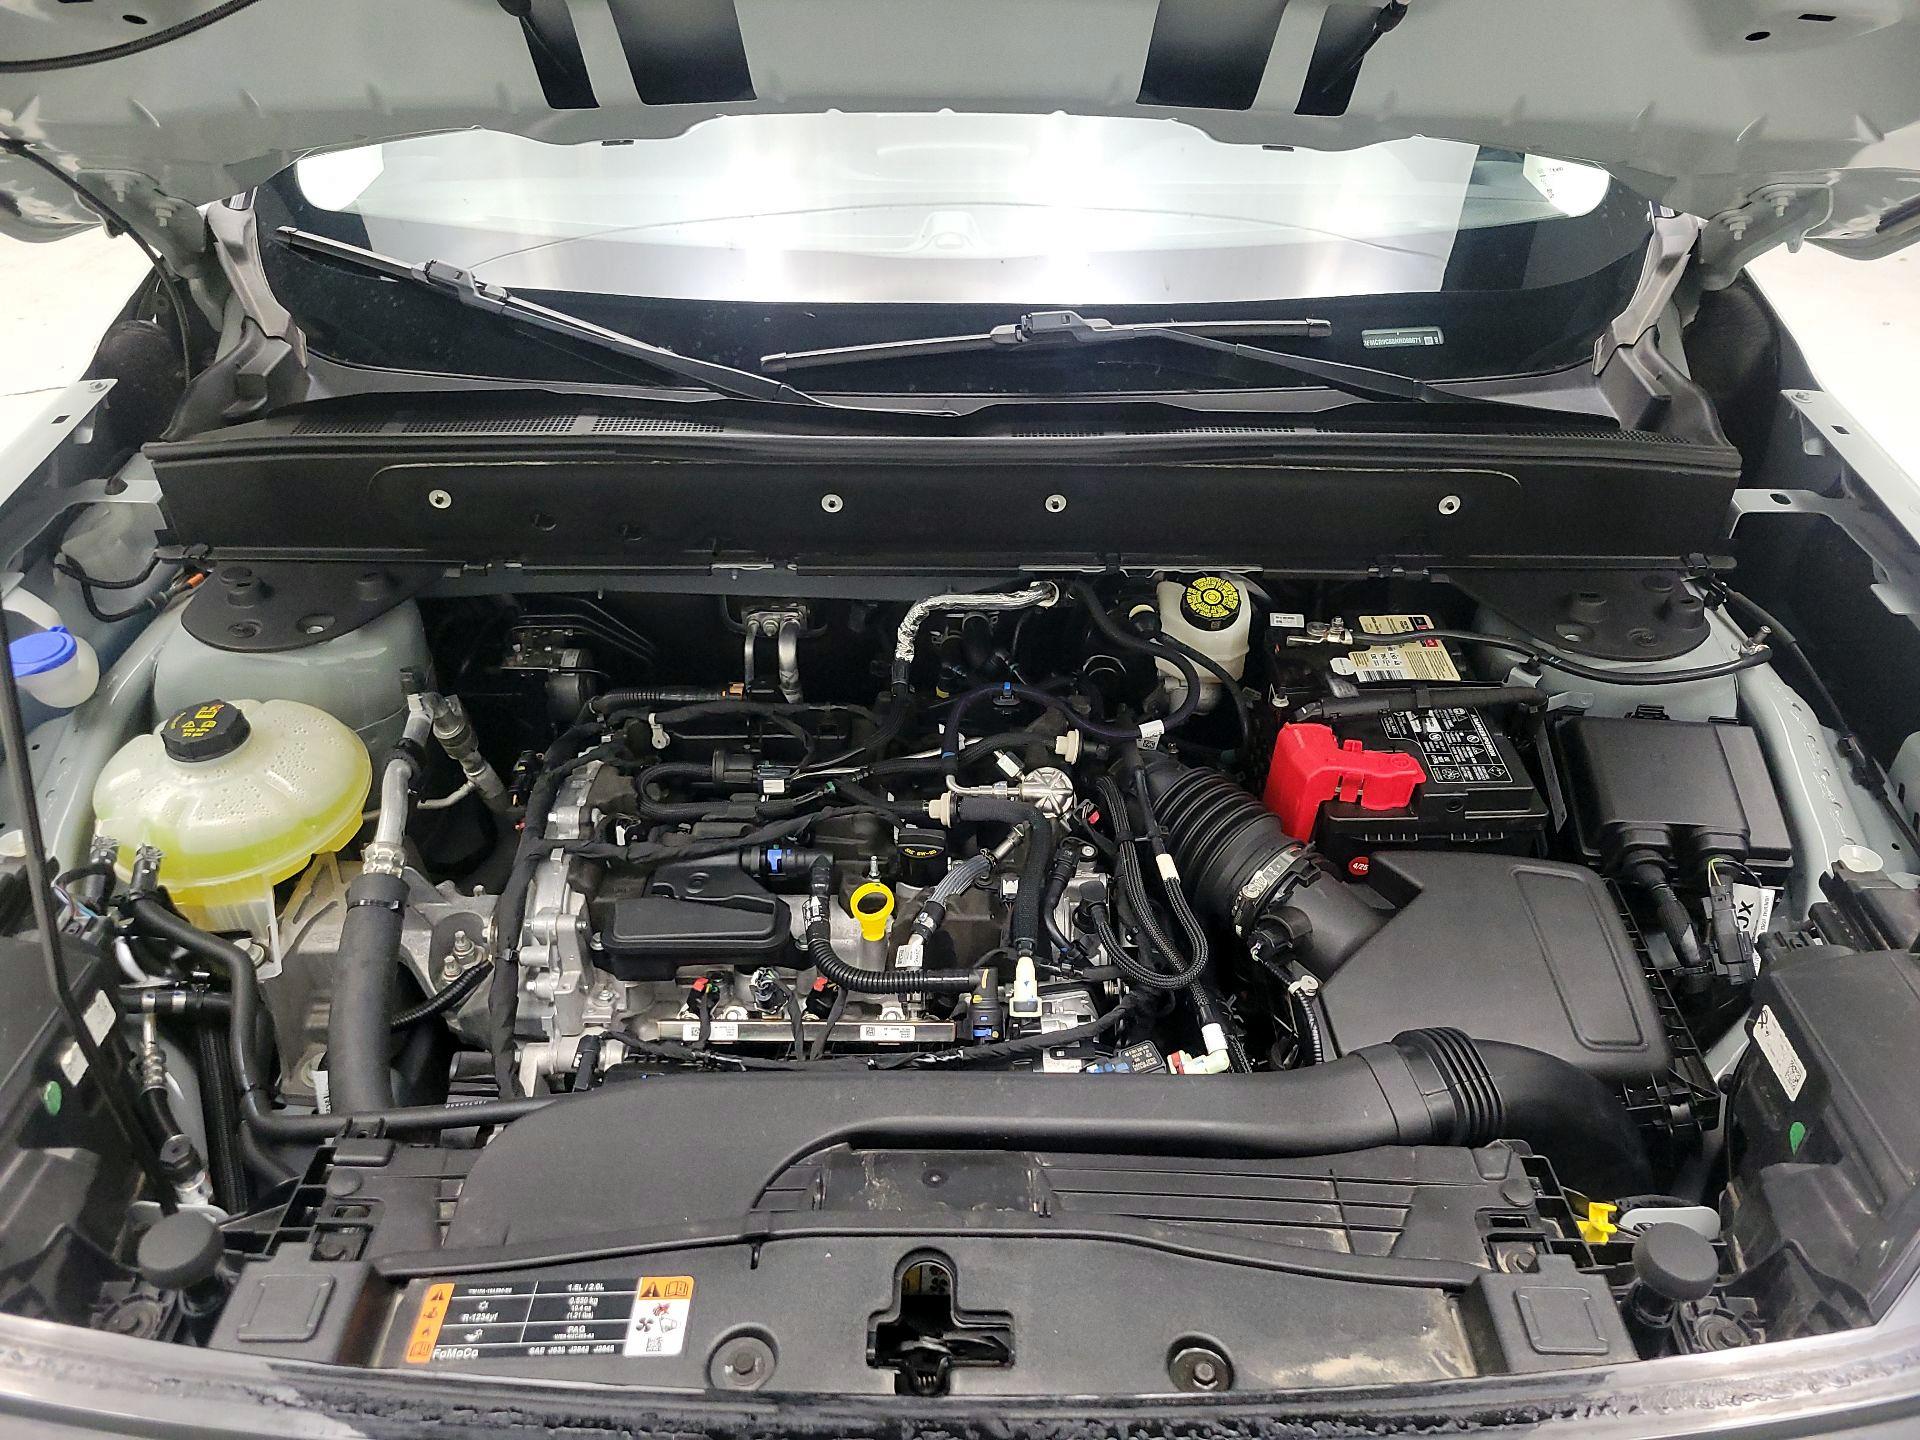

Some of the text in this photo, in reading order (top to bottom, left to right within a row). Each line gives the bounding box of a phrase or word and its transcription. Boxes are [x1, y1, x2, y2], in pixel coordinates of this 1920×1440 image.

[1352, 862, 1370, 871] 4/25
[1736, 900, 1755, 929] JX
[588, 1282, 605, 1292] 2.0L
[462, 1313, 499, 1323] R-1234yf
[432, 1347, 479, 1360] FoMoCo
